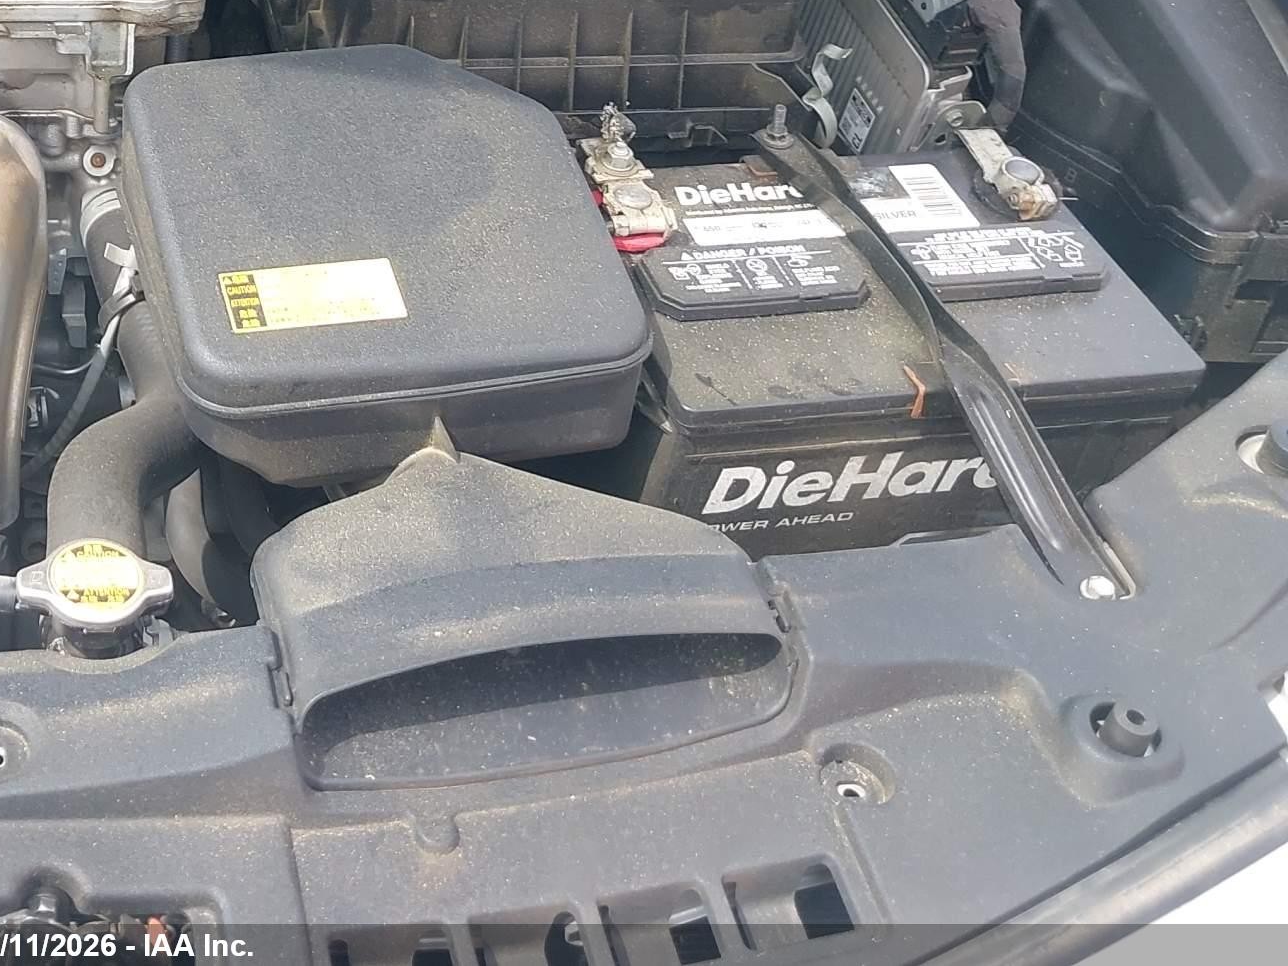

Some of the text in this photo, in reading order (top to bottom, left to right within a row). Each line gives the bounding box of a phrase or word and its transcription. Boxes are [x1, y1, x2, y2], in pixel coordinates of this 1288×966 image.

[674, 181, 803, 206] DieHar
[873, 209, 918, 221] SILVER
[774, 511, 855, 529] AHEAD
